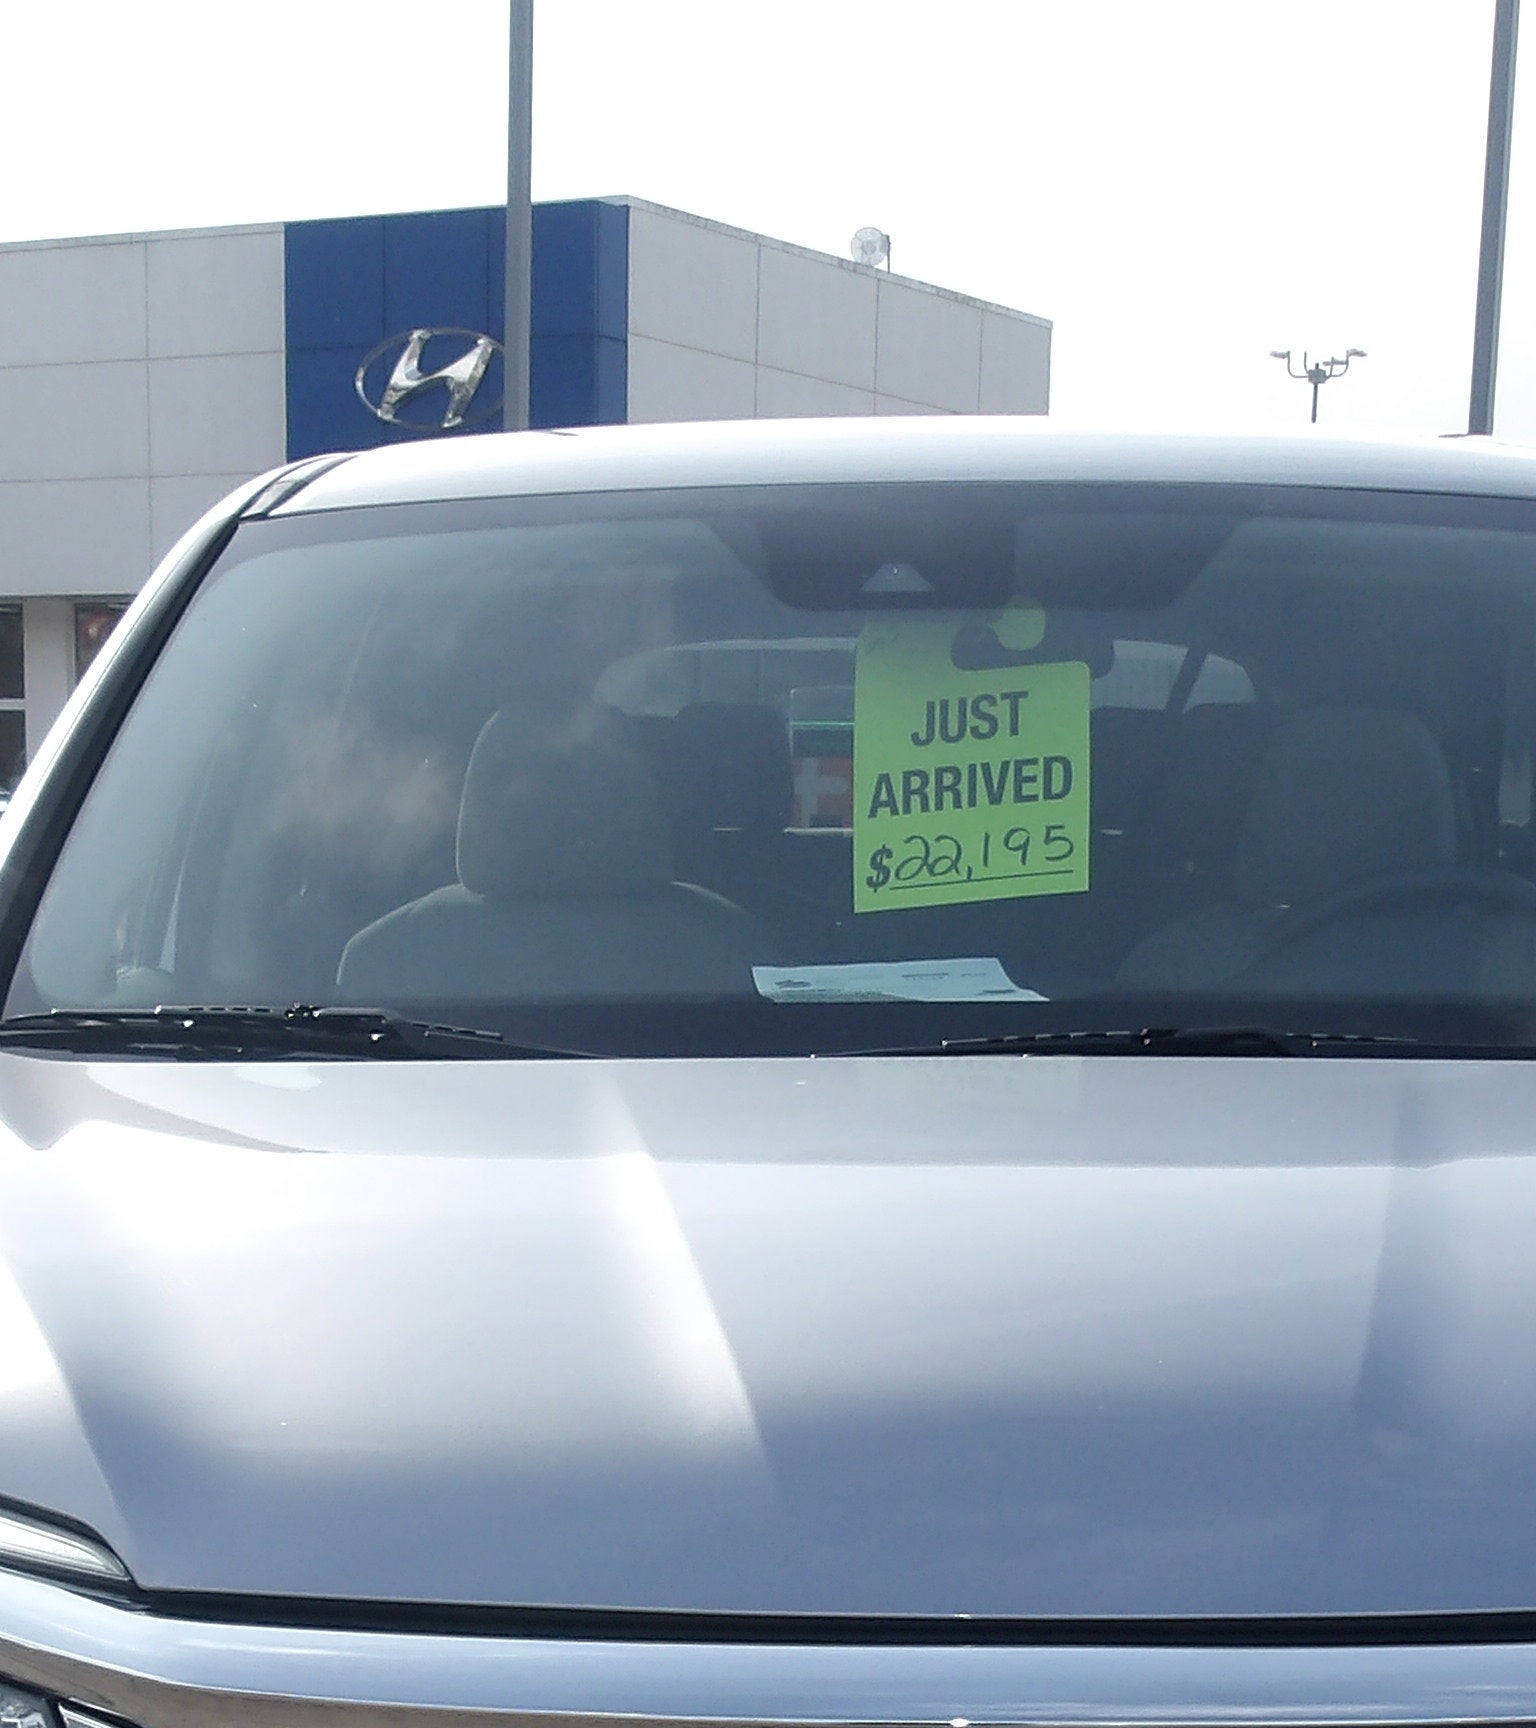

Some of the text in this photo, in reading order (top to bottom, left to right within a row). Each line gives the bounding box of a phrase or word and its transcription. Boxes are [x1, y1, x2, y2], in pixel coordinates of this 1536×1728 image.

[911, 692, 1029, 746] JUST
[868, 755, 1074, 818] ARRIVED
[866, 825, 1075, 892] $22,195
